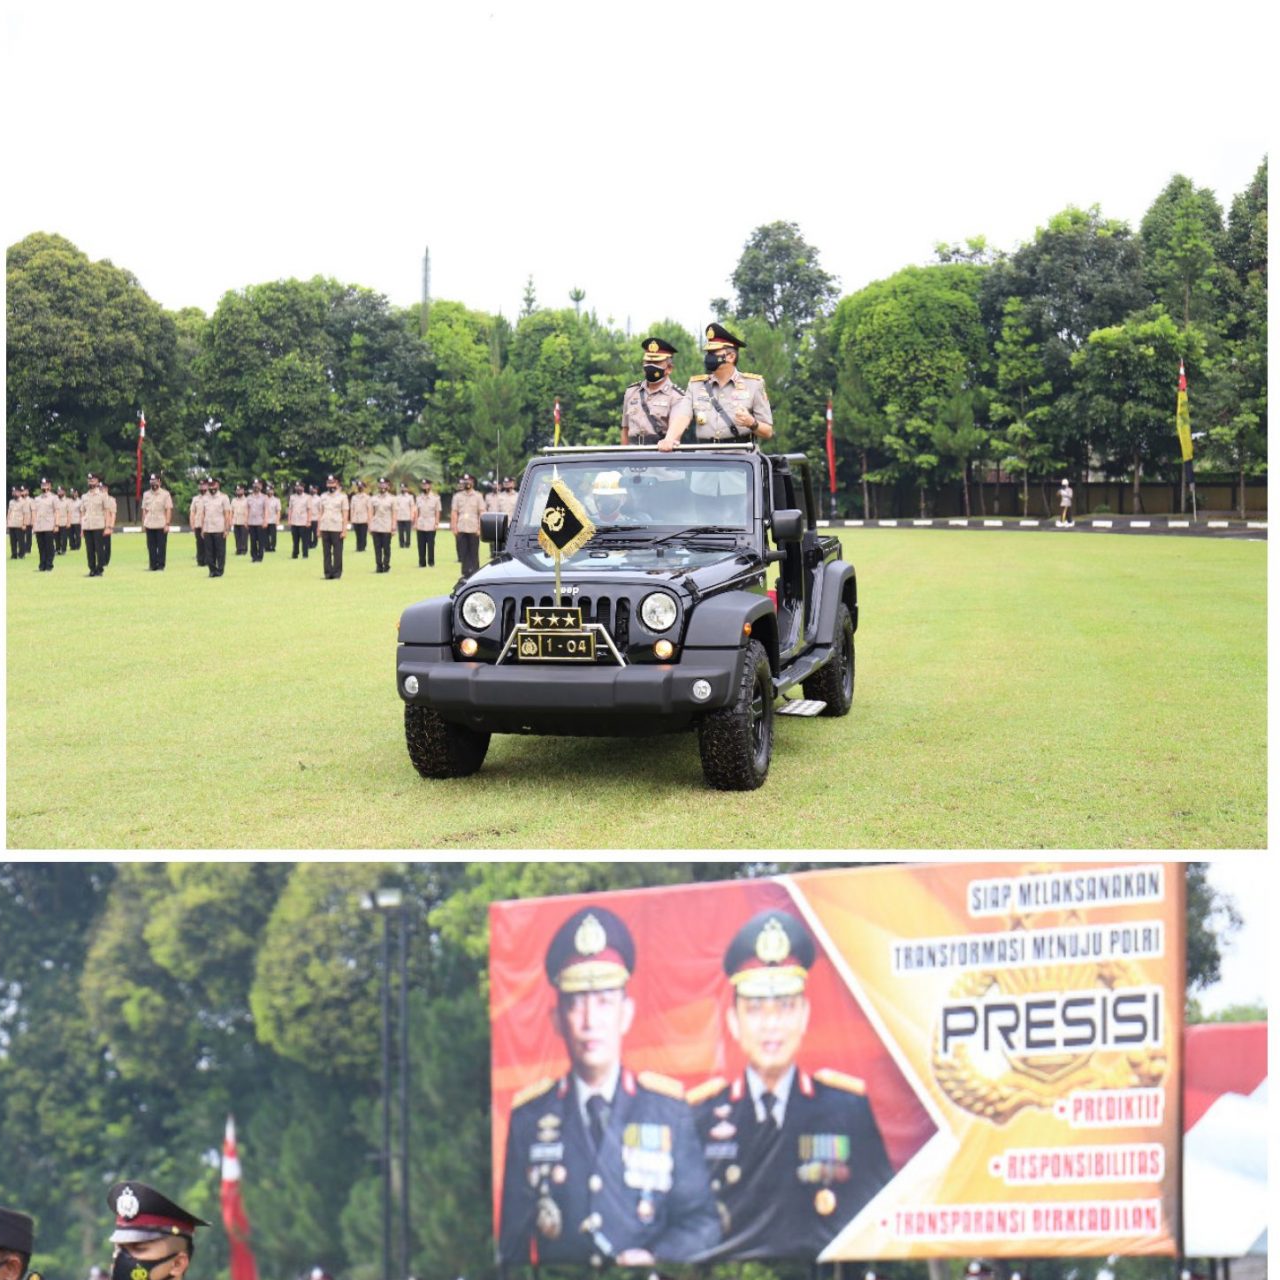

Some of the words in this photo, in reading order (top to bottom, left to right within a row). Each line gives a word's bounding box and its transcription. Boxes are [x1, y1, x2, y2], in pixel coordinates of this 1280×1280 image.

[553, 586, 579, 595] eep
[972, 882, 1011, 911] SIAP
[1019, 870, 1160, 906] MELAKSANAKAN
[894, 936, 1025, 971] TRANSFORMASI
[1032, 930, 1102, 960] MENUJU
[1110, 926, 1160, 955] POLRI
[942, 993, 1160, 1054] PRESISI
[1073, 1094, 1160, 1122] PREDIKTIF
[1007, 1150, 1160, 1179] RESPONSIBILITAS
[895, 1209, 1025, 1236] TRANSPARANSI
[1032, 1206, 1157, 1233] BERKEADILAN
